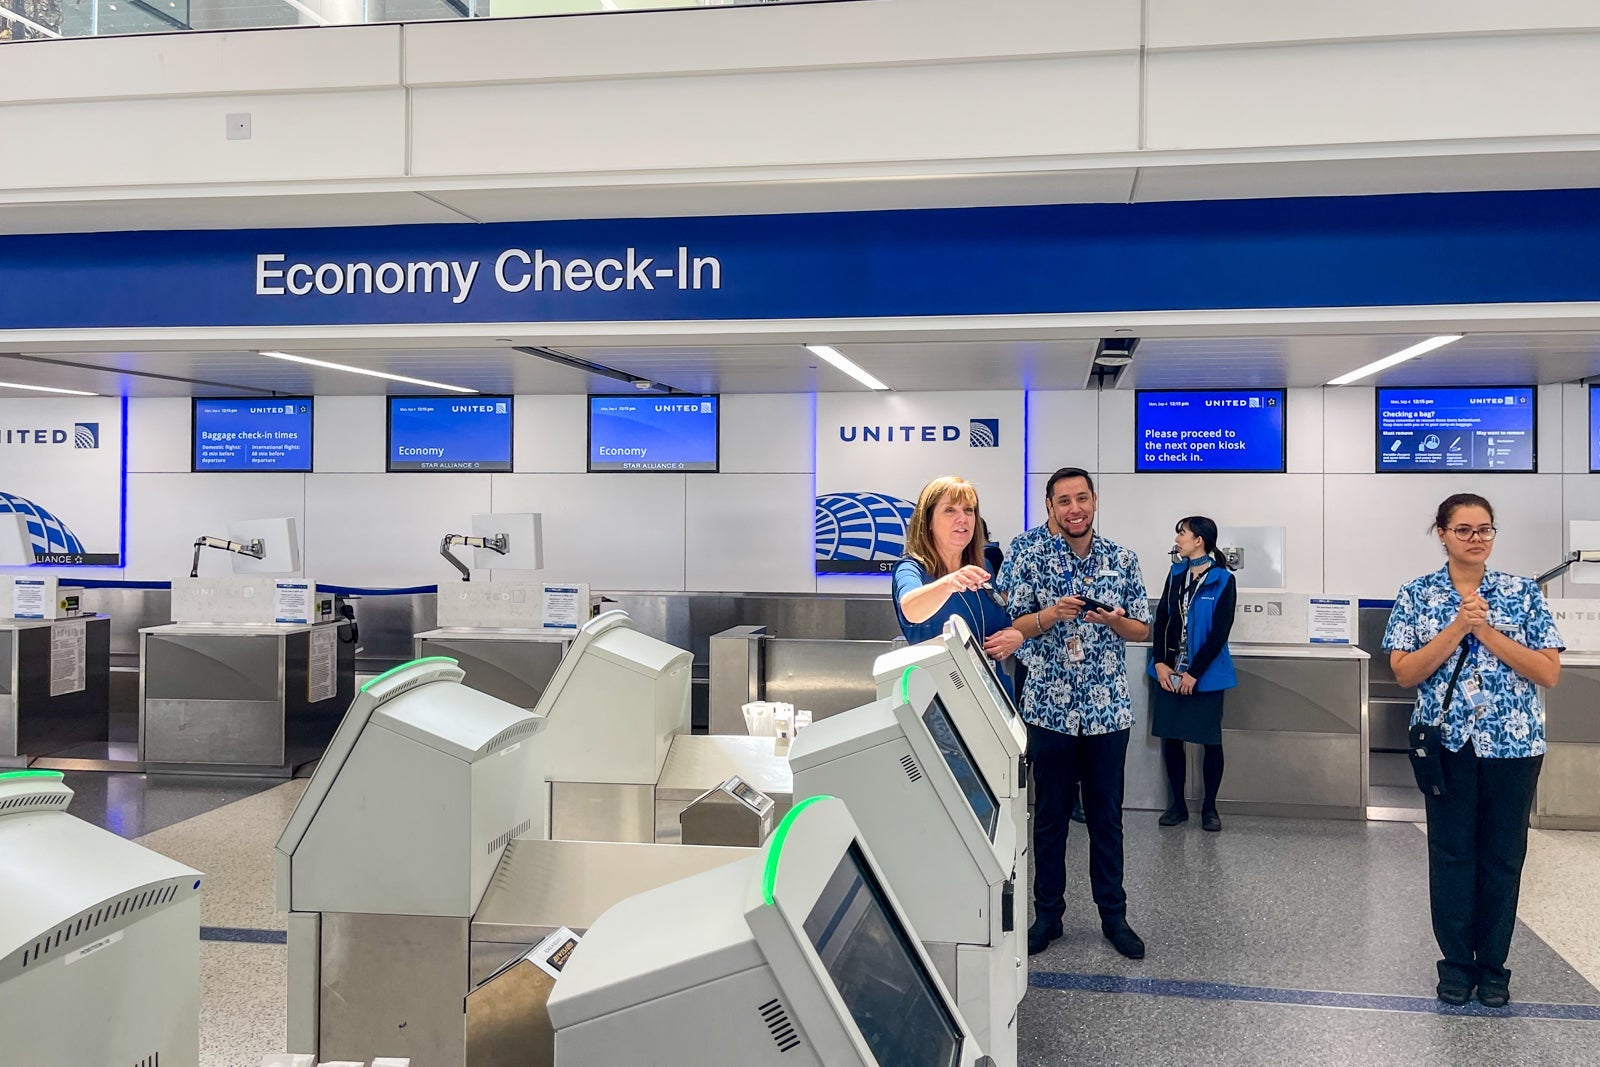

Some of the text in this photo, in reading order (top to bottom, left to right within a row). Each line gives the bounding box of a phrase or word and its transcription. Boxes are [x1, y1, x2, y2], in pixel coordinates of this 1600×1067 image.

[256, 246, 721, 304] Economy Check-In
[202, 431, 236, 441] Baggage
[840, 426, 960, 442] UNITED
[1145, 429, 1178, 438] Please
[1181, 429, 1222, 440] proceed
[1145, 441, 1161, 449] the
[1190, 443, 1215, 451] open
[1218, 441, 1246, 449] kiosk
[399, 446, 444, 457] Economy
[600, 446, 647, 458] Economy
[1158, 453, 1187, 461] check
[1190, 453, 1203, 461] in.
[36, 555, 72, 564] LIANCE
[879, 563, 893, 571] ST
